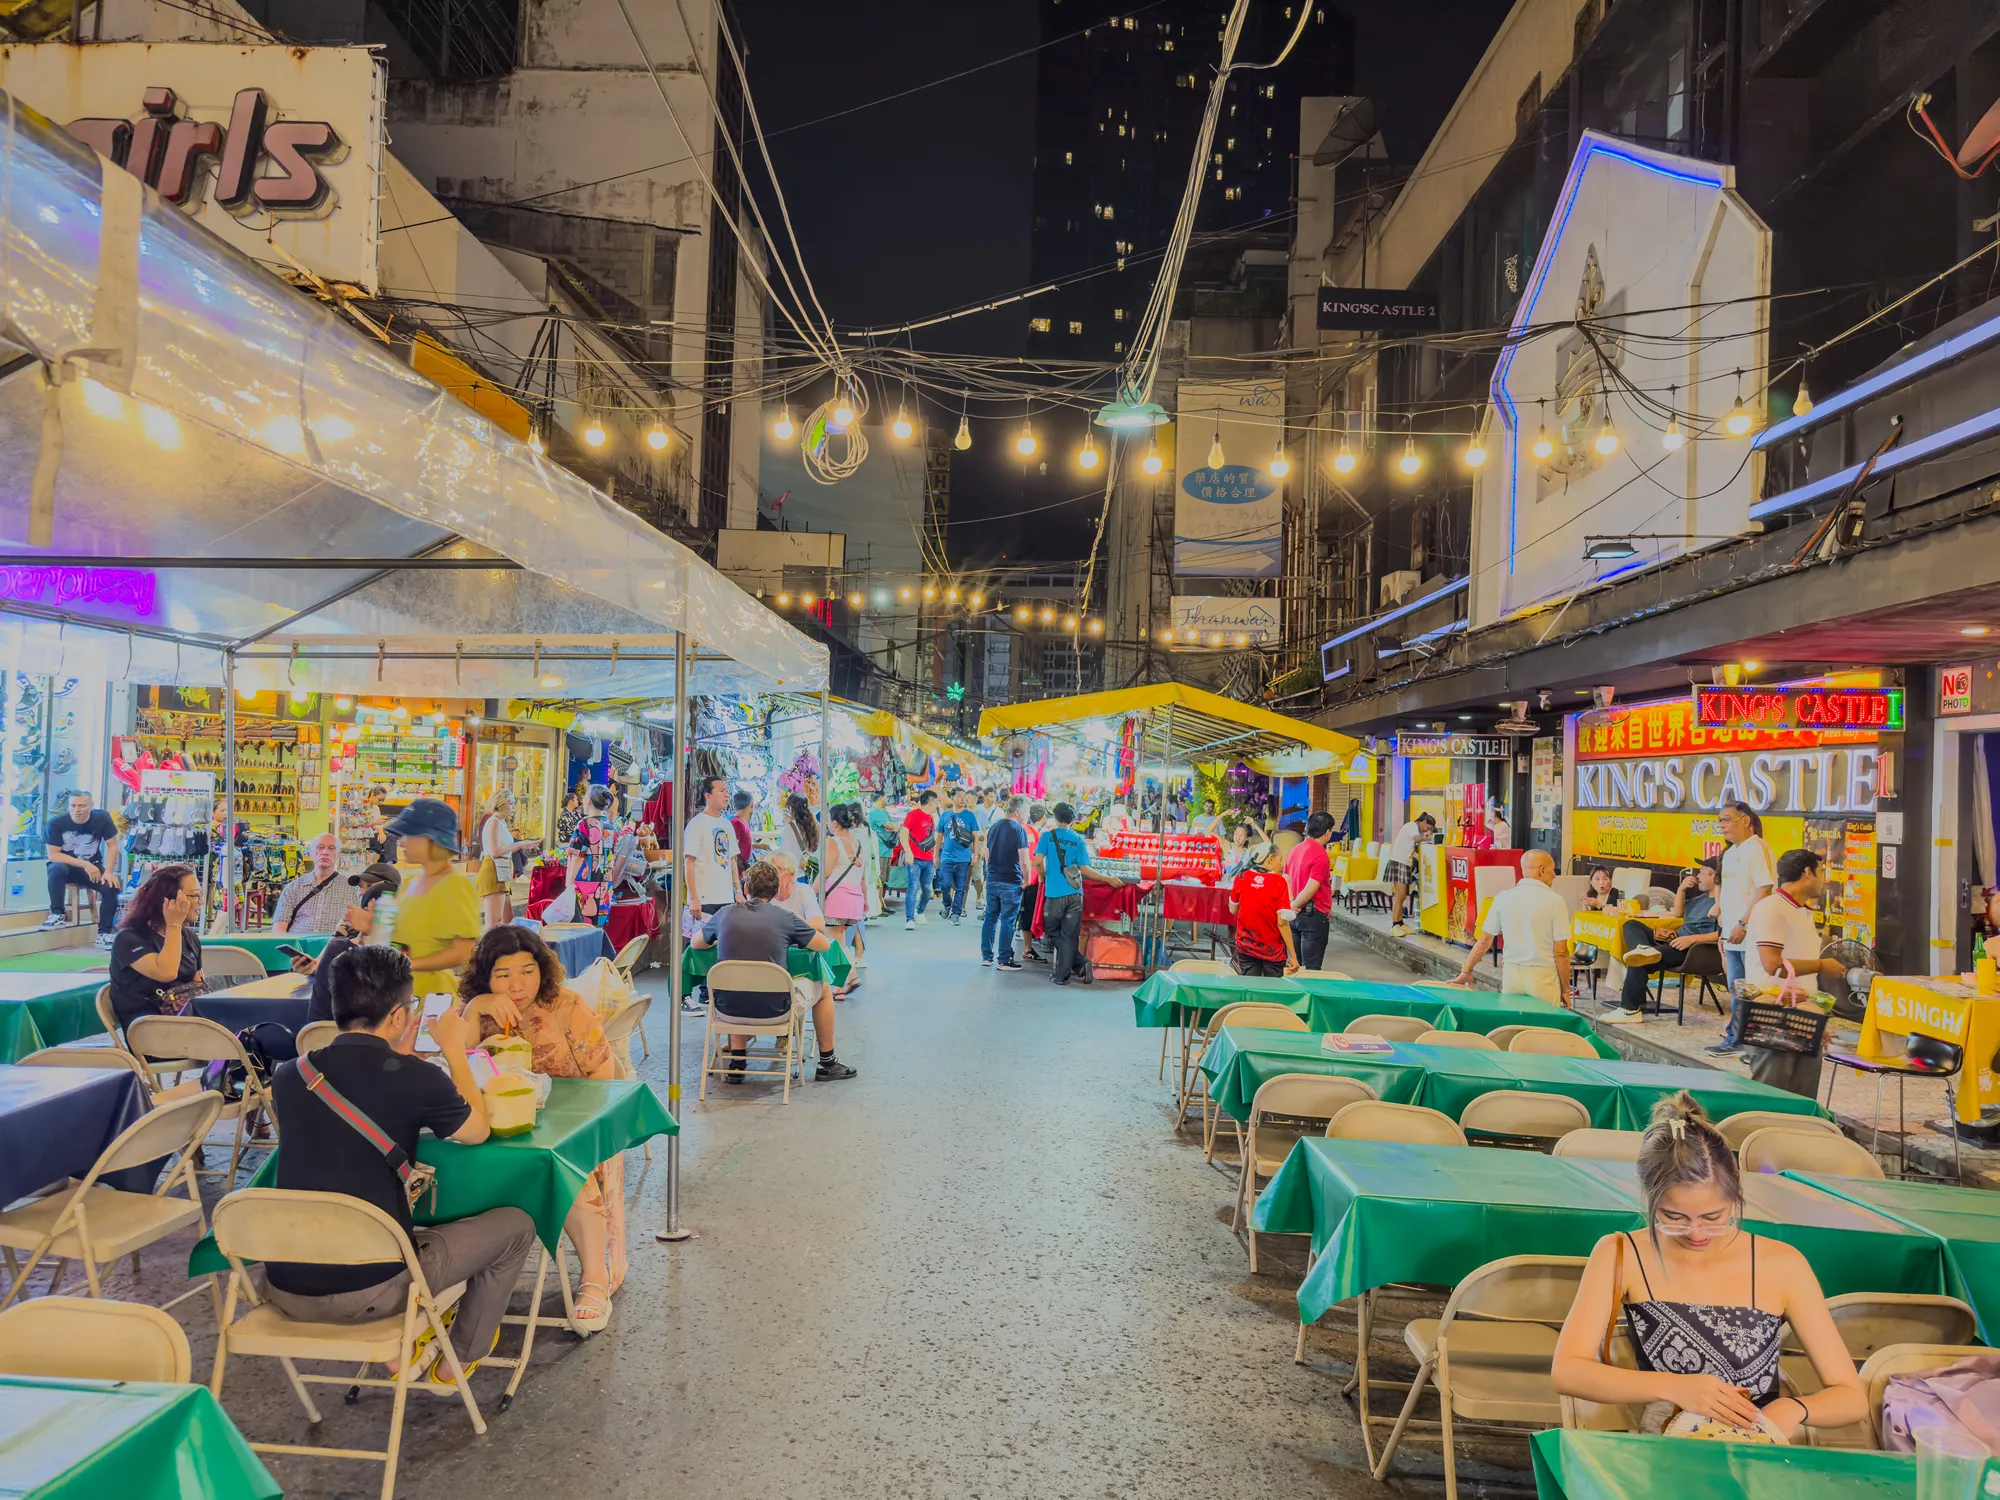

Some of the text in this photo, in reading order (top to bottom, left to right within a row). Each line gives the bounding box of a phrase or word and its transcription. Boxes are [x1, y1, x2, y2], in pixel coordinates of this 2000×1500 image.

[1428, 306, 1437, 317] 2
[1699, 693, 1787, 723] KING'S
[1795, 693, 1886, 725] CASTLE
[1943, 697, 1969, 709] PHOTO
[1401, 737, 1448, 754] KING'S
[1451, 738, 1500, 756] CASTLE
[1576, 757, 1686, 809] KING'S
[1691, 748, 1878, 813] CASTLE
[1691, 819, 1711, 836] DRAFT
[1818, 828, 1842, 840] SINGHA
[1598, 832, 1647, 860] SINGHA 100
[1452, 858, 1468, 879] LEO
